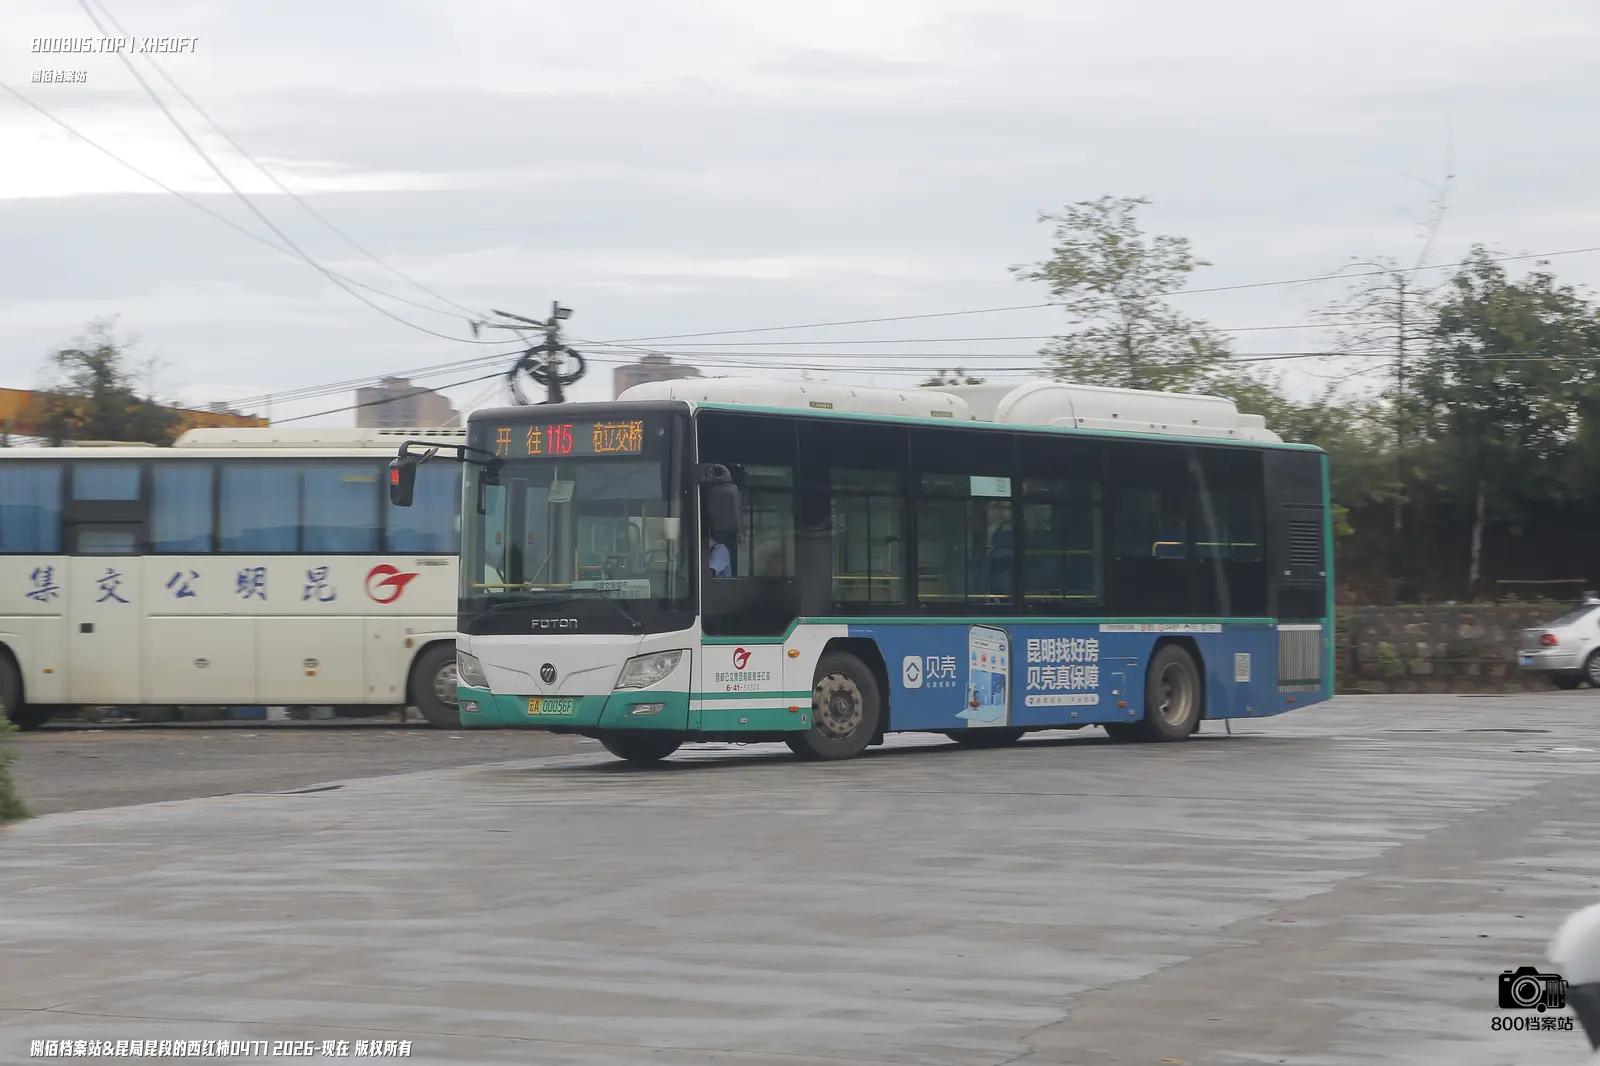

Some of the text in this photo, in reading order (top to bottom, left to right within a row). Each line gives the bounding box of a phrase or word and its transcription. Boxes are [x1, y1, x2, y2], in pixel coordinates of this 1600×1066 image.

[547, 424, 574, 454] 115
[1026, 637, 1100, 664] 昆明找好房
[926, 655, 957, 680] 贝壳
[1025, 664, 1100, 691] 贝壳真保障
